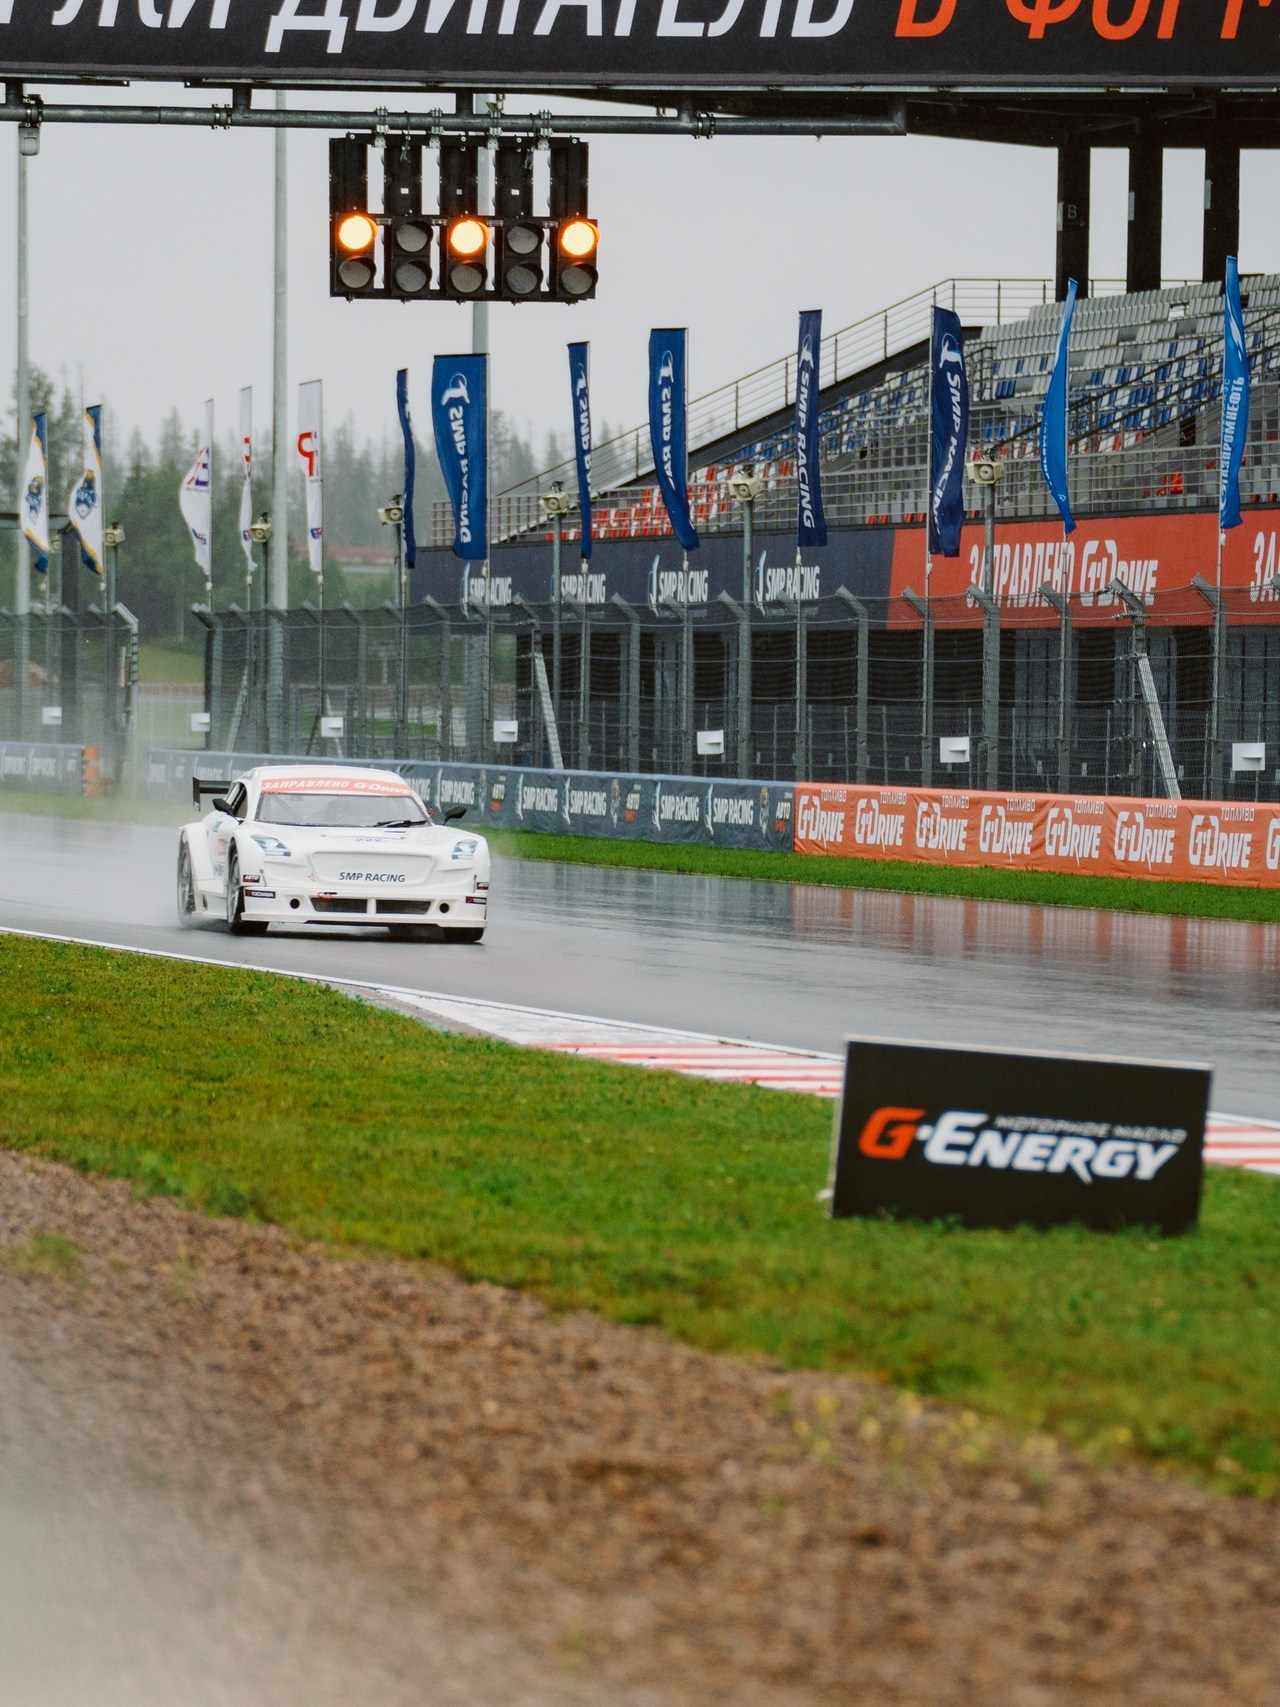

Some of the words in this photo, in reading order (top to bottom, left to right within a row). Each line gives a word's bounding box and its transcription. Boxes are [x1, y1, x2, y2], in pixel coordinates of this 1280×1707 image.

[797, 370, 810, 428] SMP
[945, 372, 961, 431] SMP
[796, 431, 815, 529] RACING
[659, 571, 677, 603] SMP
[765, 568, 785, 601] SMP
[262, 779, 350, 790] ЗАПРАВЛЕНО
[522, 786, 536, 811] SMP
[536, 788, 558, 812] RACING
[570, 790, 585, 815] SMP
[585, 791, 607, 816] RACING
[821, 789, 847, 802] ТОПЛИВО
[880, 791, 907, 805] ТОПЛИВО
[942, 795, 970, 809] ТОПЛИВО
[1006, 798, 1036, 812] ТОПЛИВО
[660, 795, 675, 820] SMP
[675, 795, 700, 822] RACING
[713, 798, 728, 824] SMP
[728, 799, 754, 825] RACING
[1074, 800, 1105, 814] ТОПЛИВО
[1146, 803, 1178, 818] ТОПЛИВО
[1221, 807, 1255, 822] ТОПЛИВО
[339, 871, 363, 881] SMP
[364, 873, 406, 883] RACING
